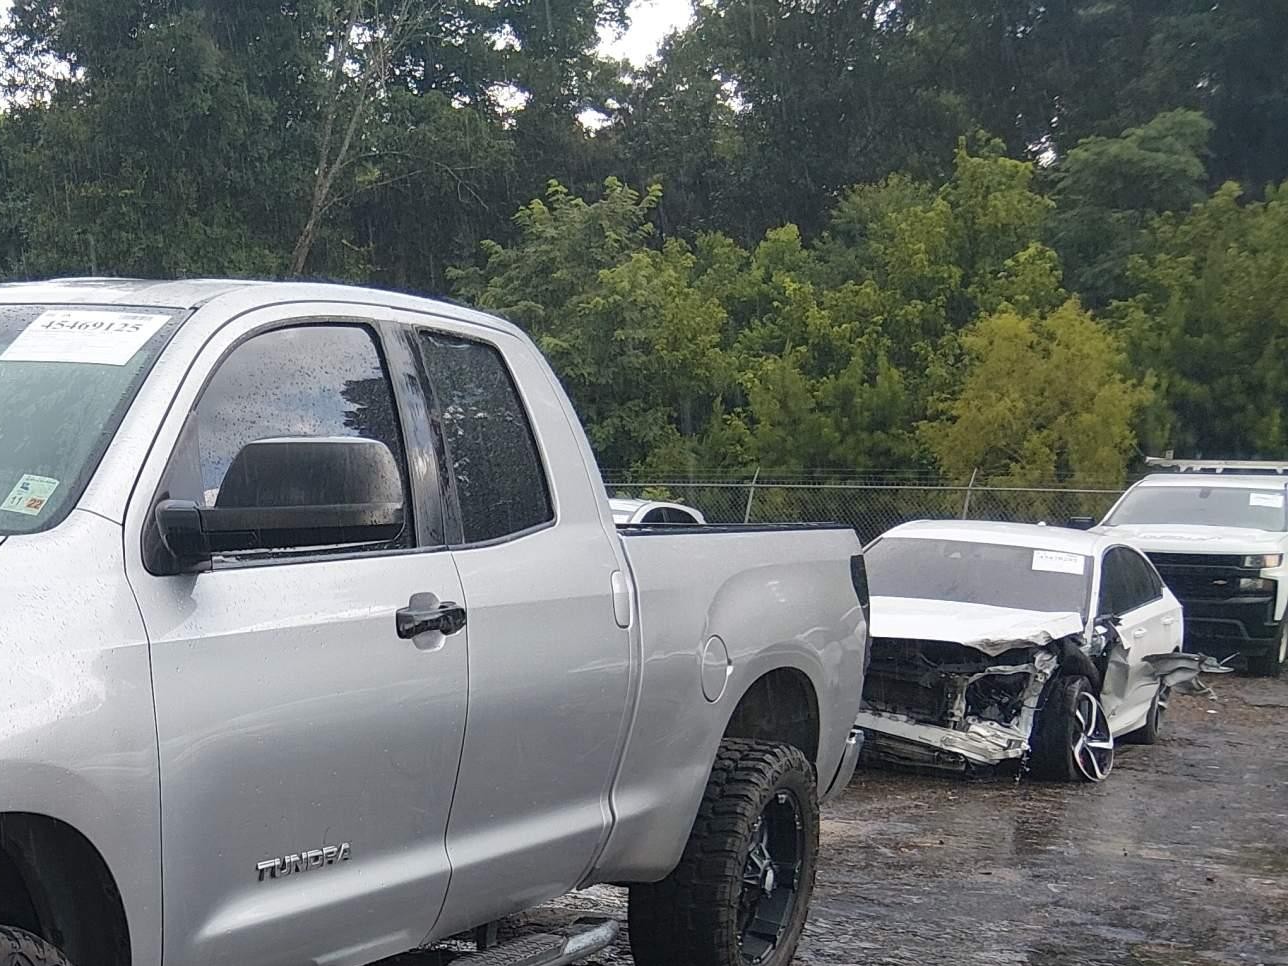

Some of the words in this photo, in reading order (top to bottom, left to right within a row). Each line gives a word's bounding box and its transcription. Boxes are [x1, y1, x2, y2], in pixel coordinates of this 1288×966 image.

[40, 320, 143, 333] 45469125
[27, 498, 43, 510] 22
[256, 842, 352, 881] TUNDRA
